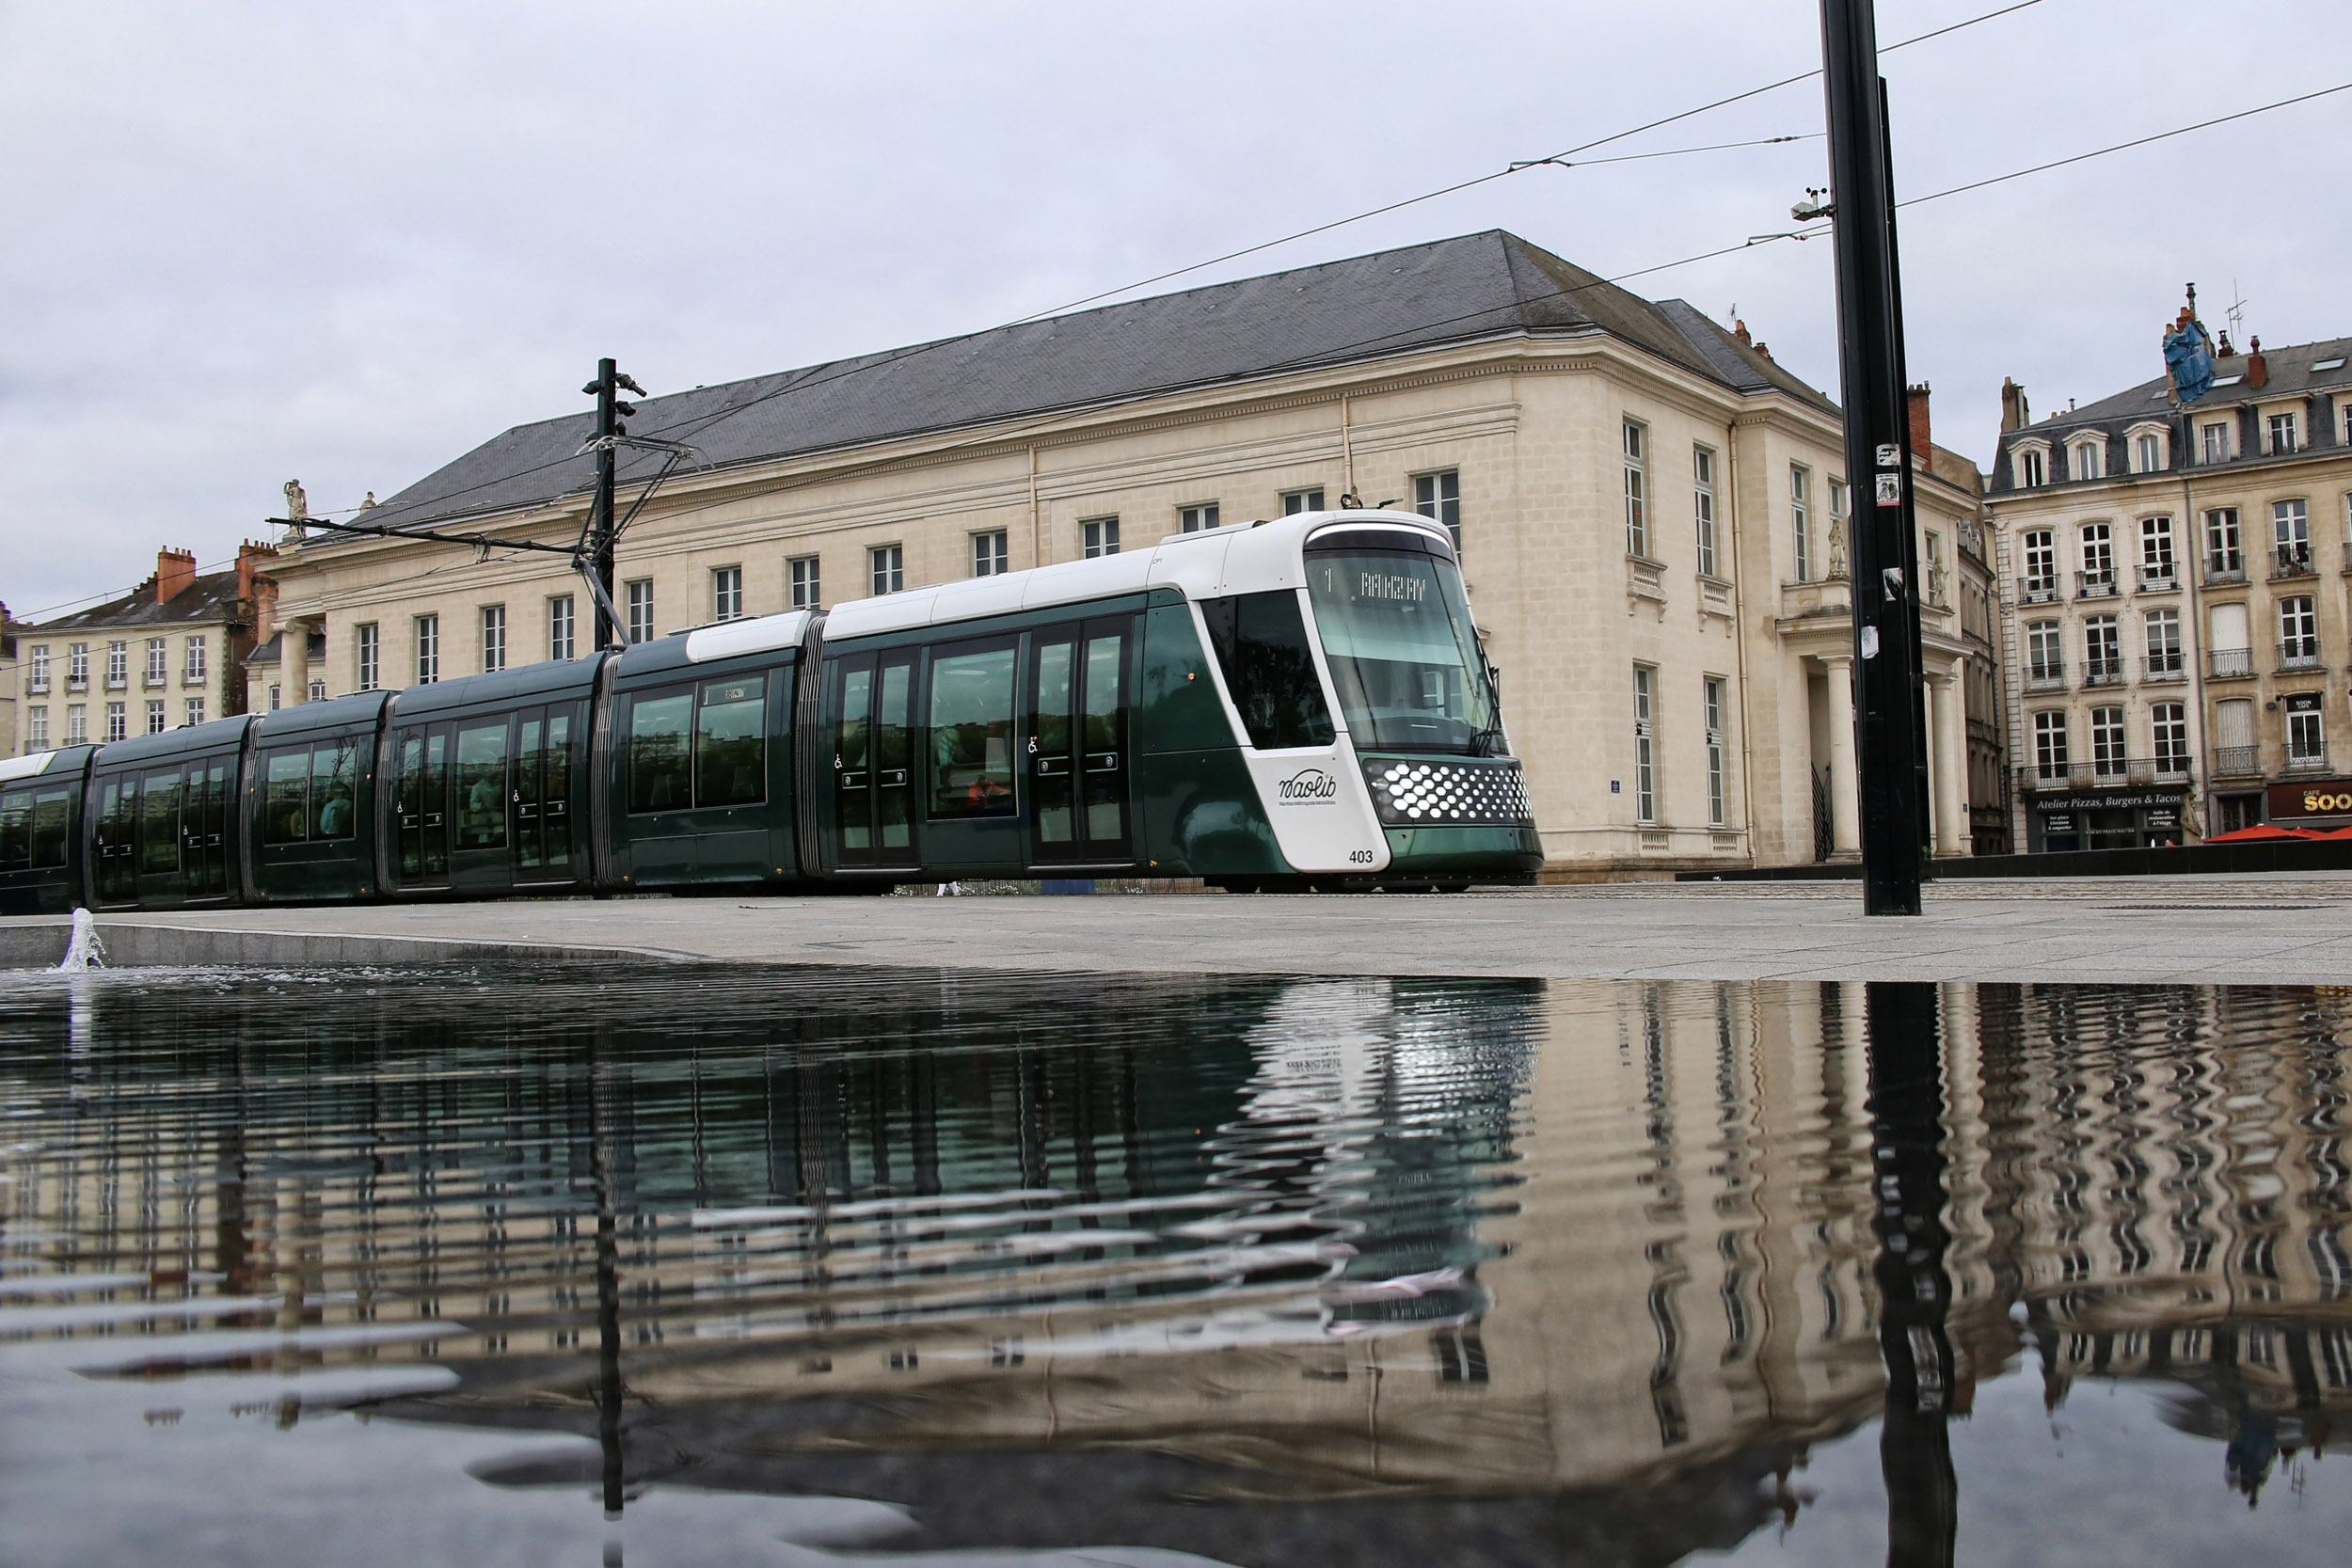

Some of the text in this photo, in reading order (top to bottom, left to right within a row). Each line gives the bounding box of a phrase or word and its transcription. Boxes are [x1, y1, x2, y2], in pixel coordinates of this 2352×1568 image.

[1325, 567, 1332, 593] 1
[1279, 768, 1336, 799] naolib
[2037, 794, 2181, 809] Atelier Pizzas, Burgers & Tacos
[1349, 849, 1374, 863] 403
